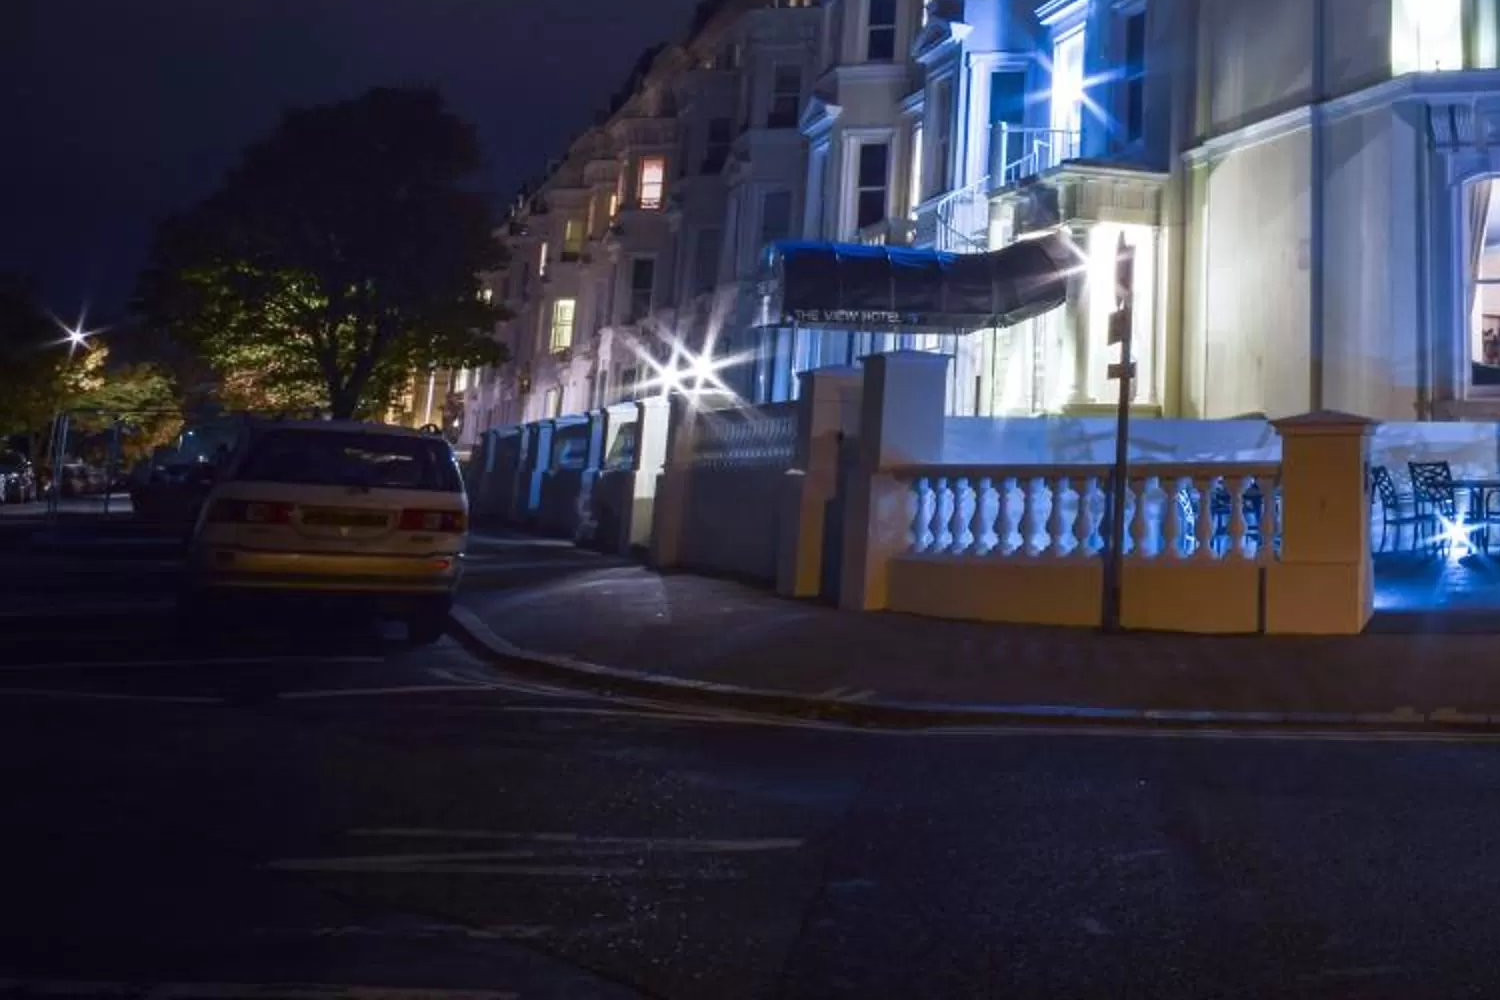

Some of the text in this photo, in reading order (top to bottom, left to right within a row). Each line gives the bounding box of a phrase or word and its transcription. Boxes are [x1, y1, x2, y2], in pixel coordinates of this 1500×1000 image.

[796, 308, 902, 323] THE VIEW HOTEL
